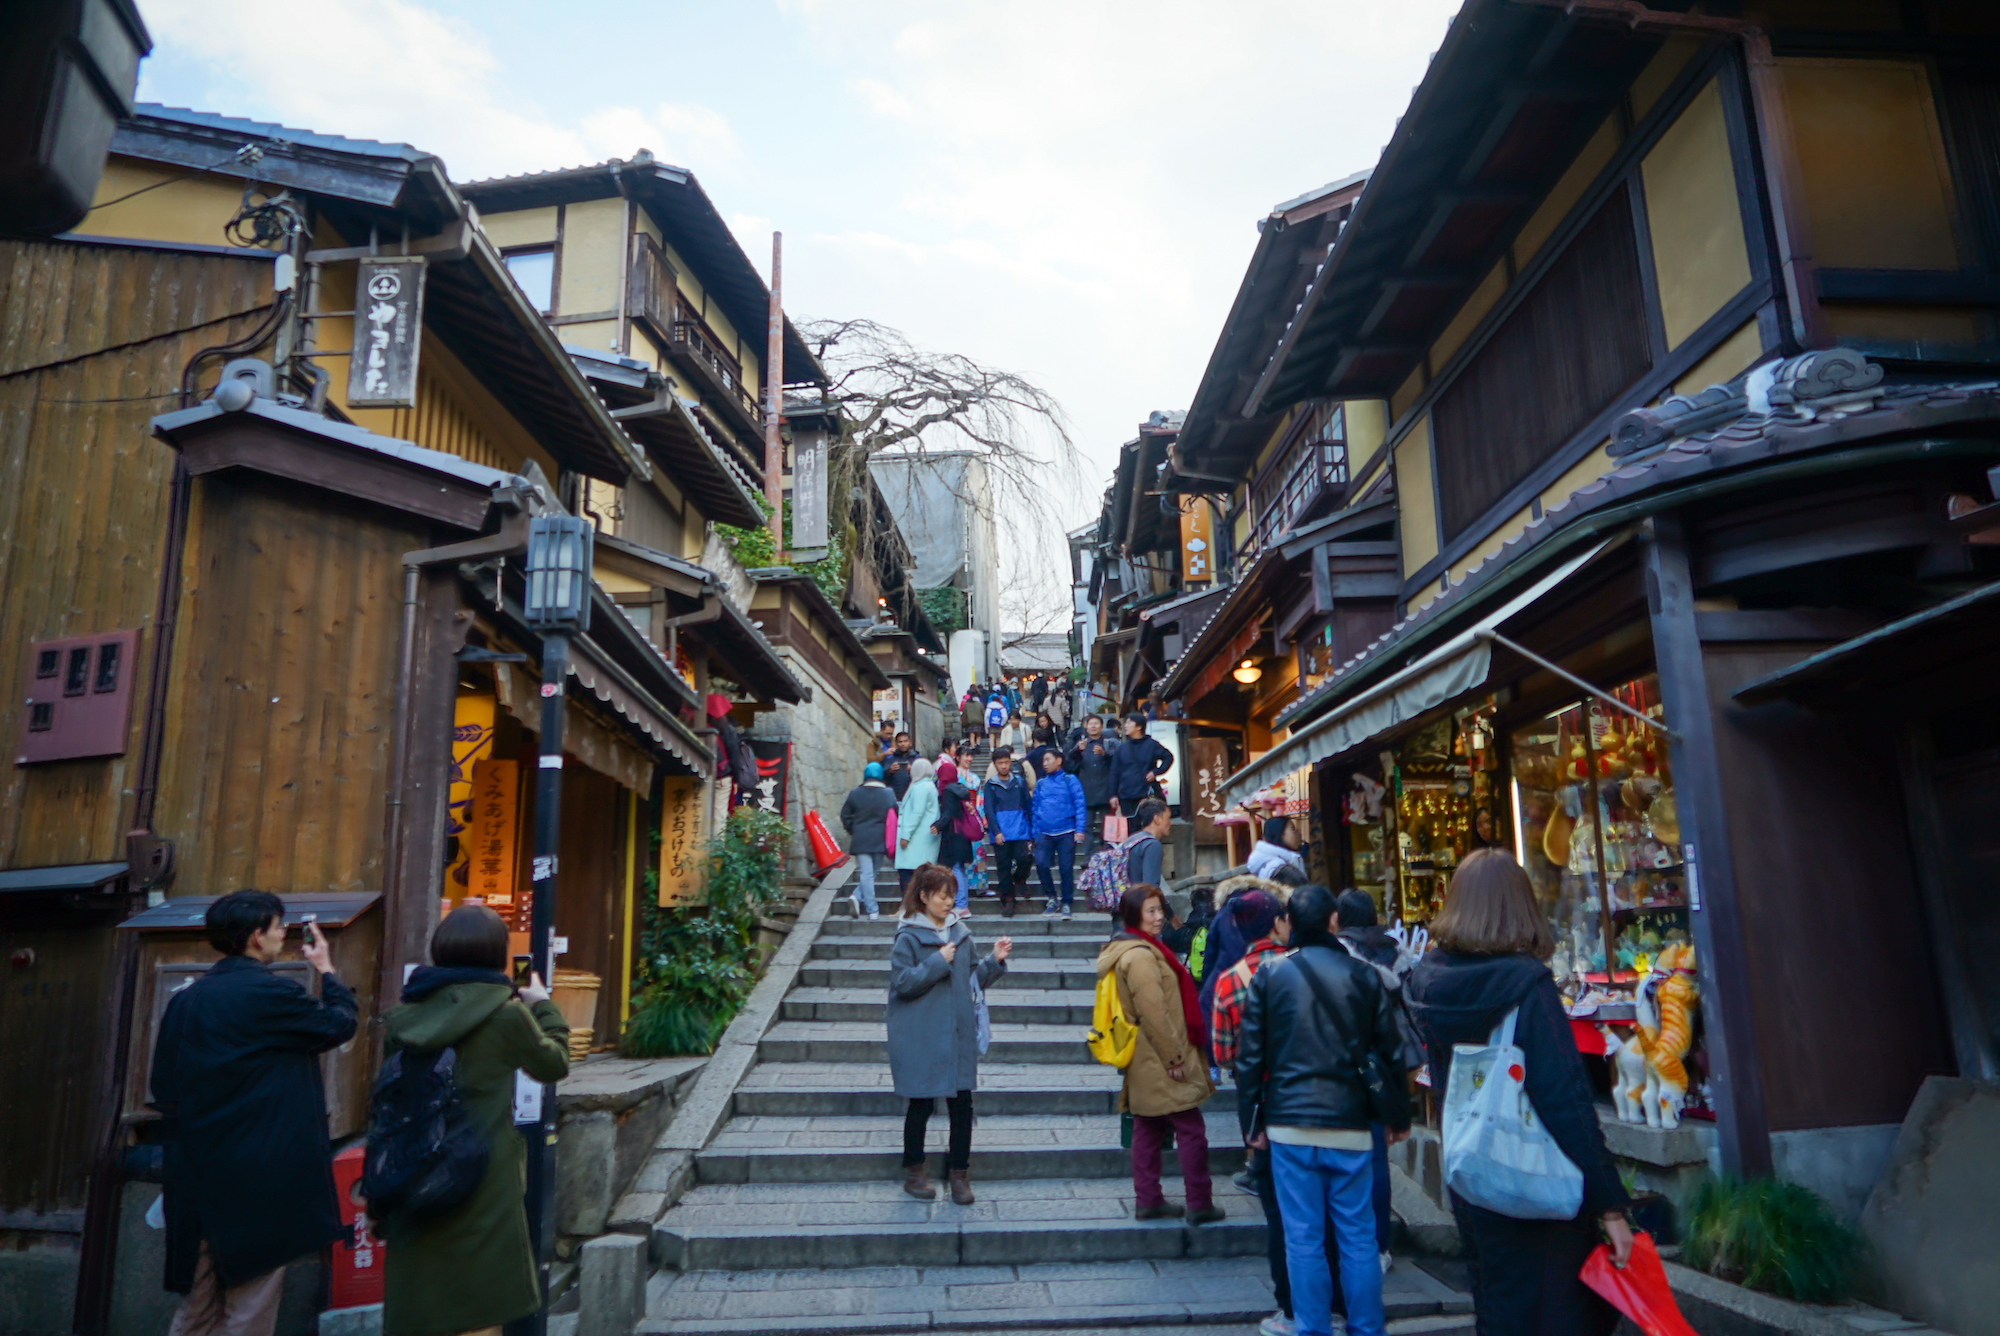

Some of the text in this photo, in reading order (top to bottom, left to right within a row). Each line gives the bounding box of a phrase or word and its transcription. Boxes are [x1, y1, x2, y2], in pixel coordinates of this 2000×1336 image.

[670, 789, 686, 878] 京のおつけもの
[354, 1211, 373, 1269] 消火器
